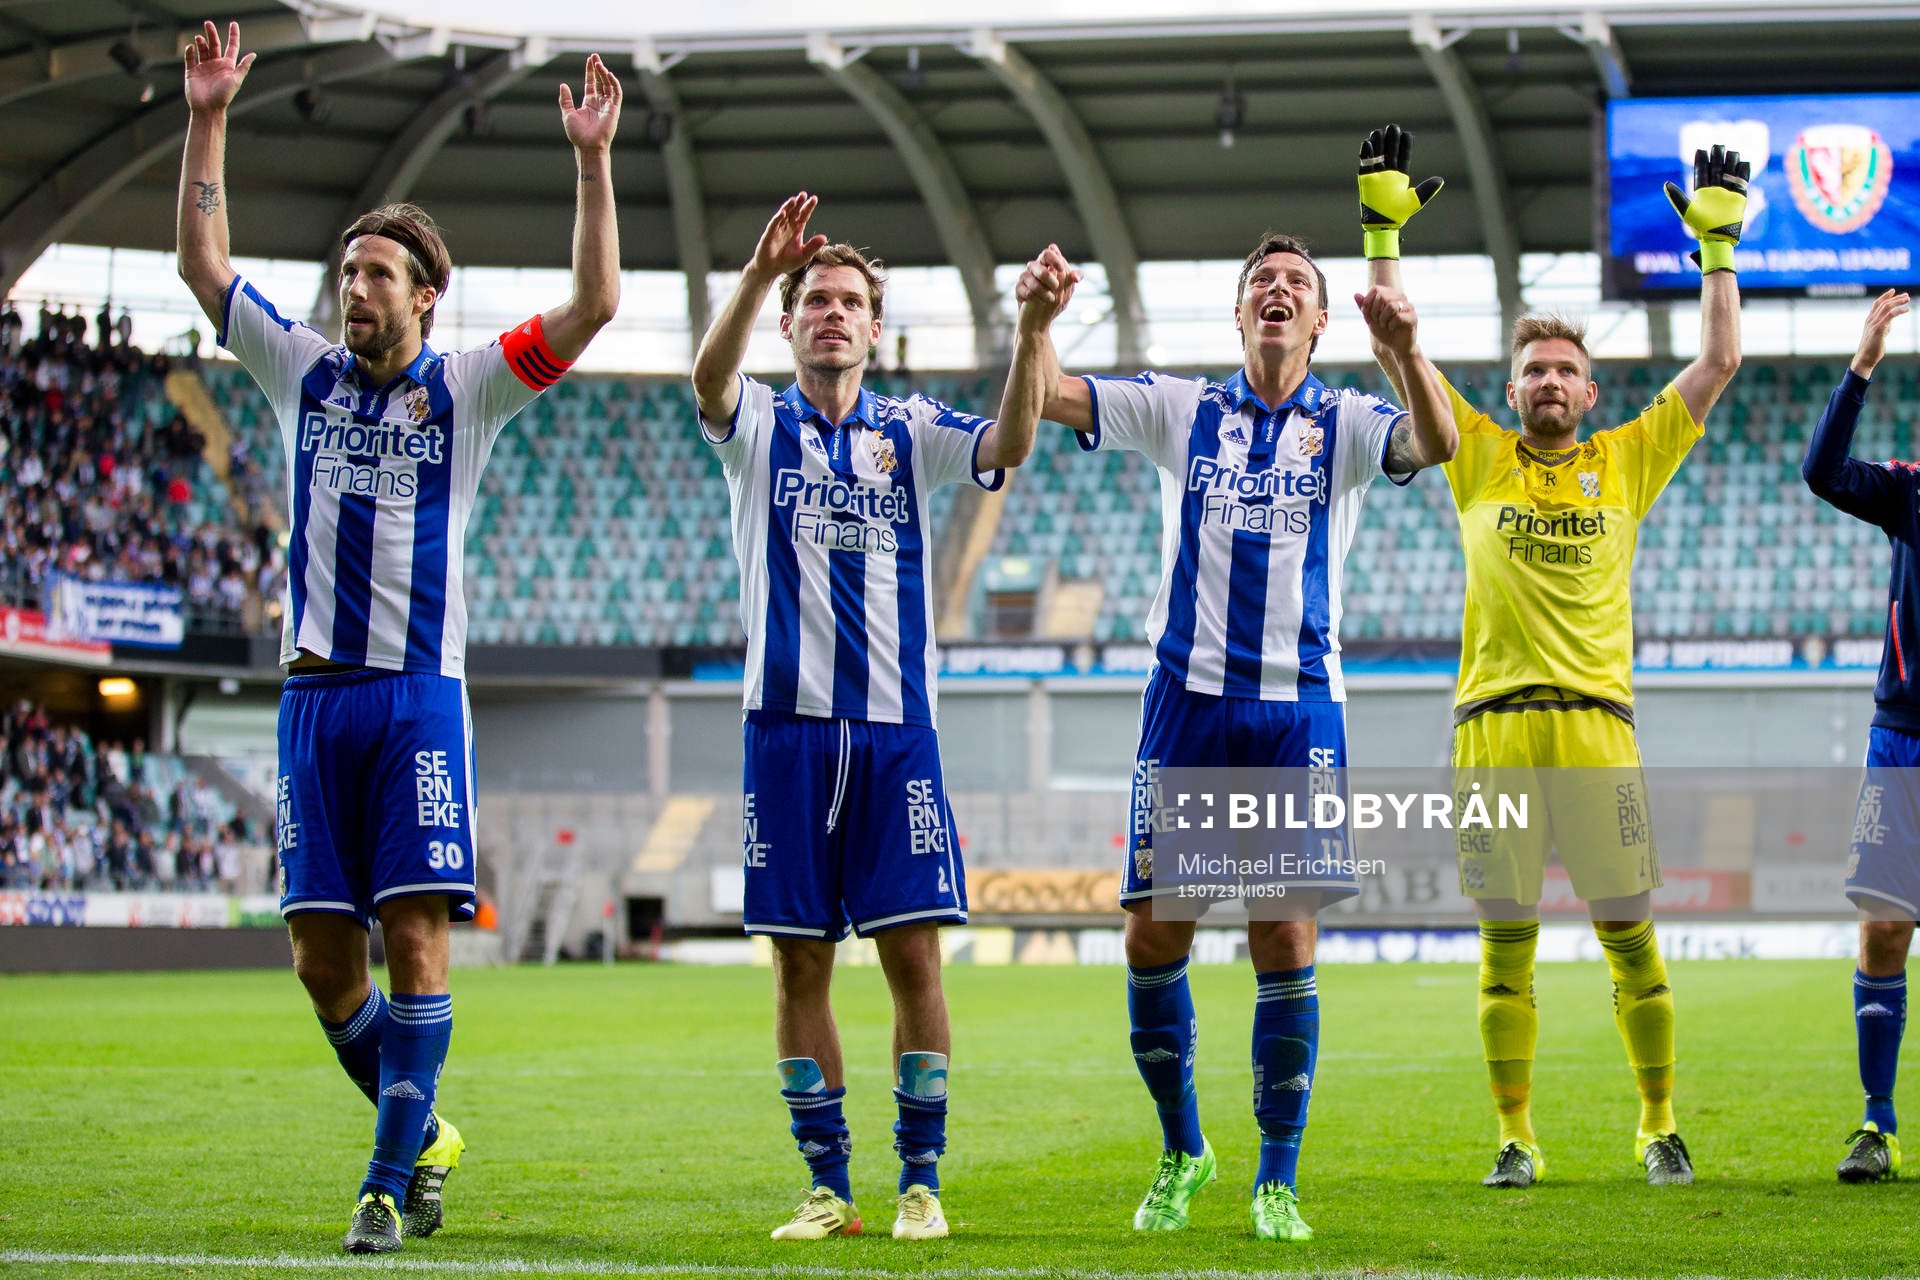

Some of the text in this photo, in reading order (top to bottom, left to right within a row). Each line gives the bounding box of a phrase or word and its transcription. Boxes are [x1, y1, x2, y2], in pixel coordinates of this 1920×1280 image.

[303, 413, 443, 463] Prioritet
[1220, 432, 1249, 446] adidas
[312, 455, 415, 498] Finans
[1190, 457, 1327, 504] Prioritet
[1543, 472, 1557, 487] R
[775, 469, 908, 522] Prioritet
[1203, 494, 1309, 534] Finans
[1496, 506, 1606, 537] Prioritet
[794, 512, 897, 553] Finans
[1508, 536, 1593, 565] Finans
[415, 750, 448, 776] SE
[1135, 759, 1160, 785] SE
[1309, 748, 1335, 773] SE
[416, 776, 452, 802] RN
[906, 779, 934, 804] SE
[1135, 783, 1164, 810] RN
[1615, 783, 1637, 805] SE
[1860, 785, 1884, 806] SE
[417, 801, 461, 829] EKE
[744, 793, 755, 817] E
[908, 804, 940, 829] RN
[1617, 803, 1642, 827] RN
[1856, 804, 1882, 825] RN
[743, 818, 758, 843] N
[1134, 807, 1177, 835] EKE
[910, 829, 945, 855] EKE
[1459, 833, 1492, 854] EKE
[1620, 823, 1647, 847] EKE
[1851, 824, 1885, 845] EKE
[427, 840, 465, 870] 30
[743, 843, 767, 868] KE
[382, 1089, 425, 1101] adidas
